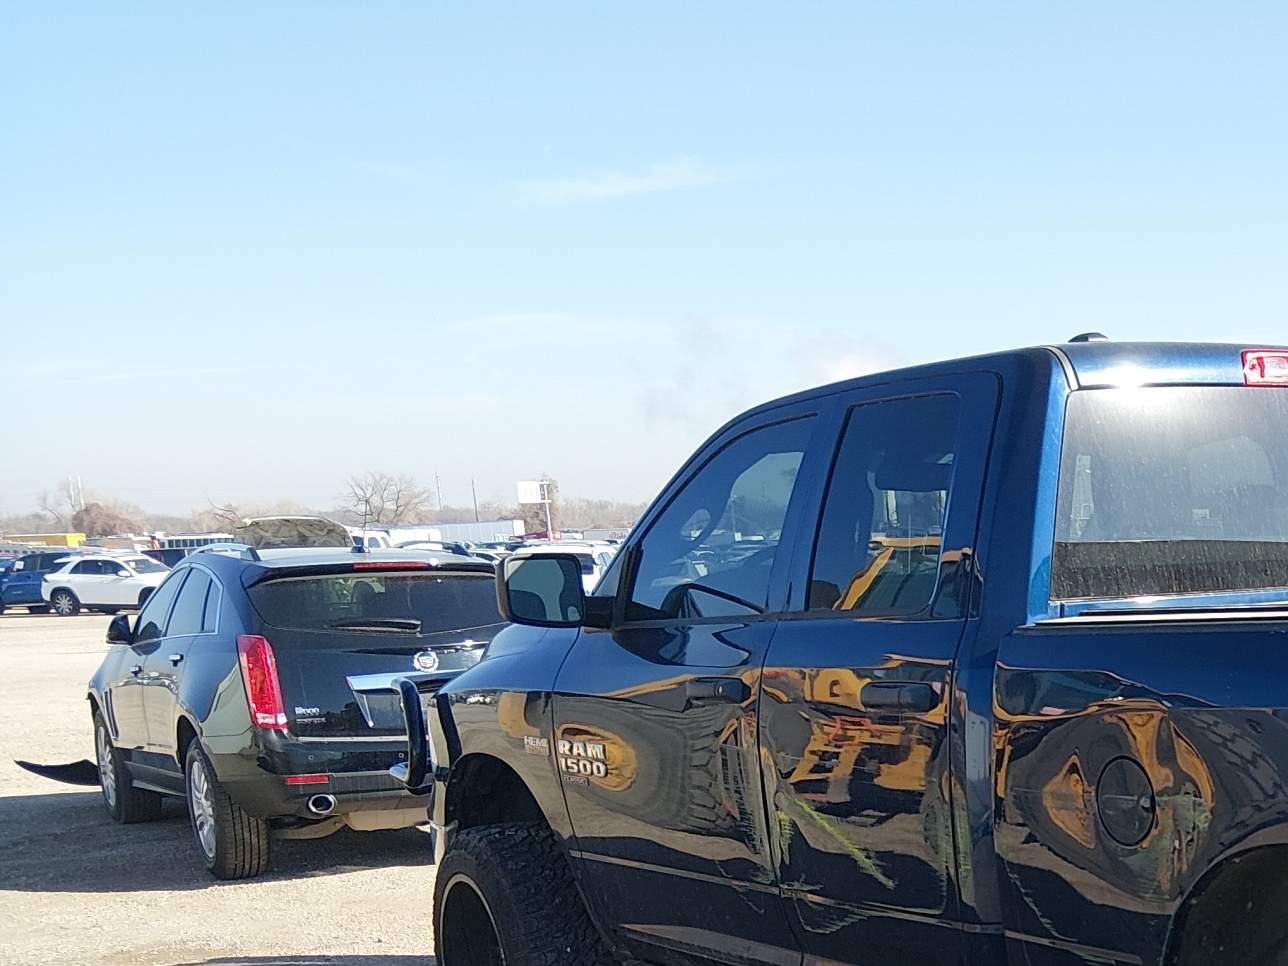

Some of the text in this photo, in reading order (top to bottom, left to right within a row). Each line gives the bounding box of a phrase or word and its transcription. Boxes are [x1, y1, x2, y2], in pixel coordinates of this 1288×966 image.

[524, 736, 549, 748] HEMI
[558, 740, 605, 760] RAM
[560, 757, 608, 778] 1500
